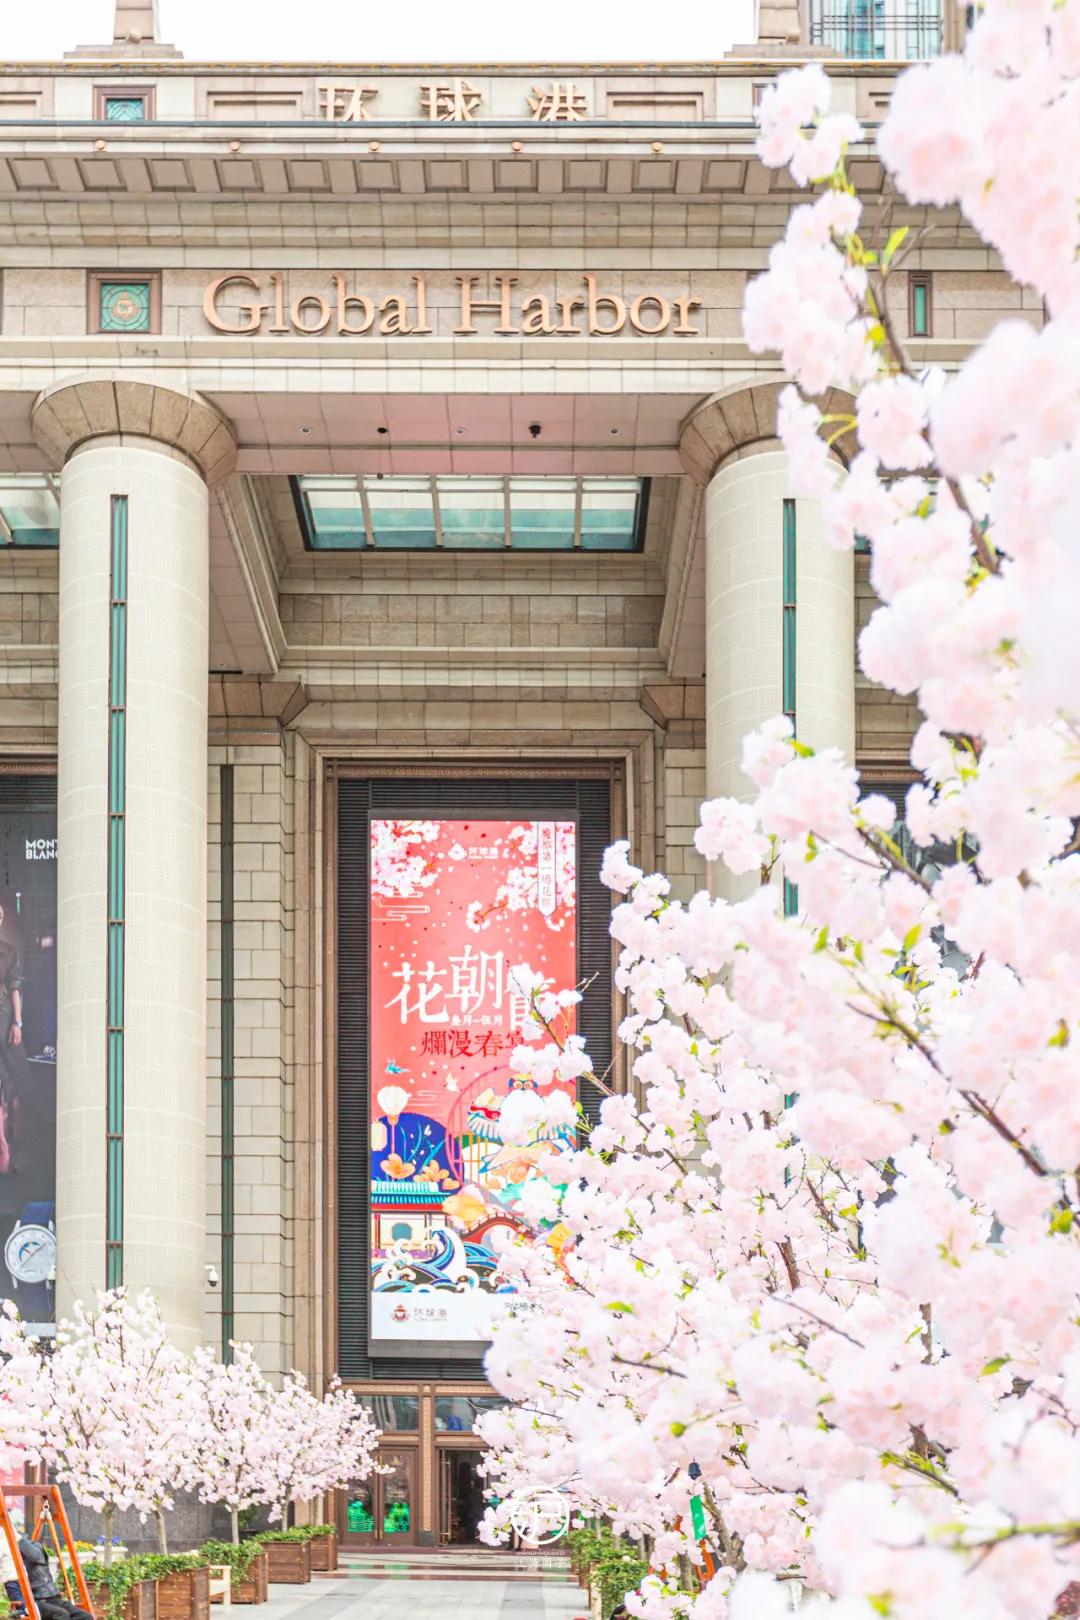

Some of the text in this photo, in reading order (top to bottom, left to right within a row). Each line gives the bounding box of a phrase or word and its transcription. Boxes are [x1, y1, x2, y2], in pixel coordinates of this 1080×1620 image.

[319, 79, 587, 121] 环球港
[202, 271, 704, 336] Global Harbor
[25, 849, 58, 860] BLAN
